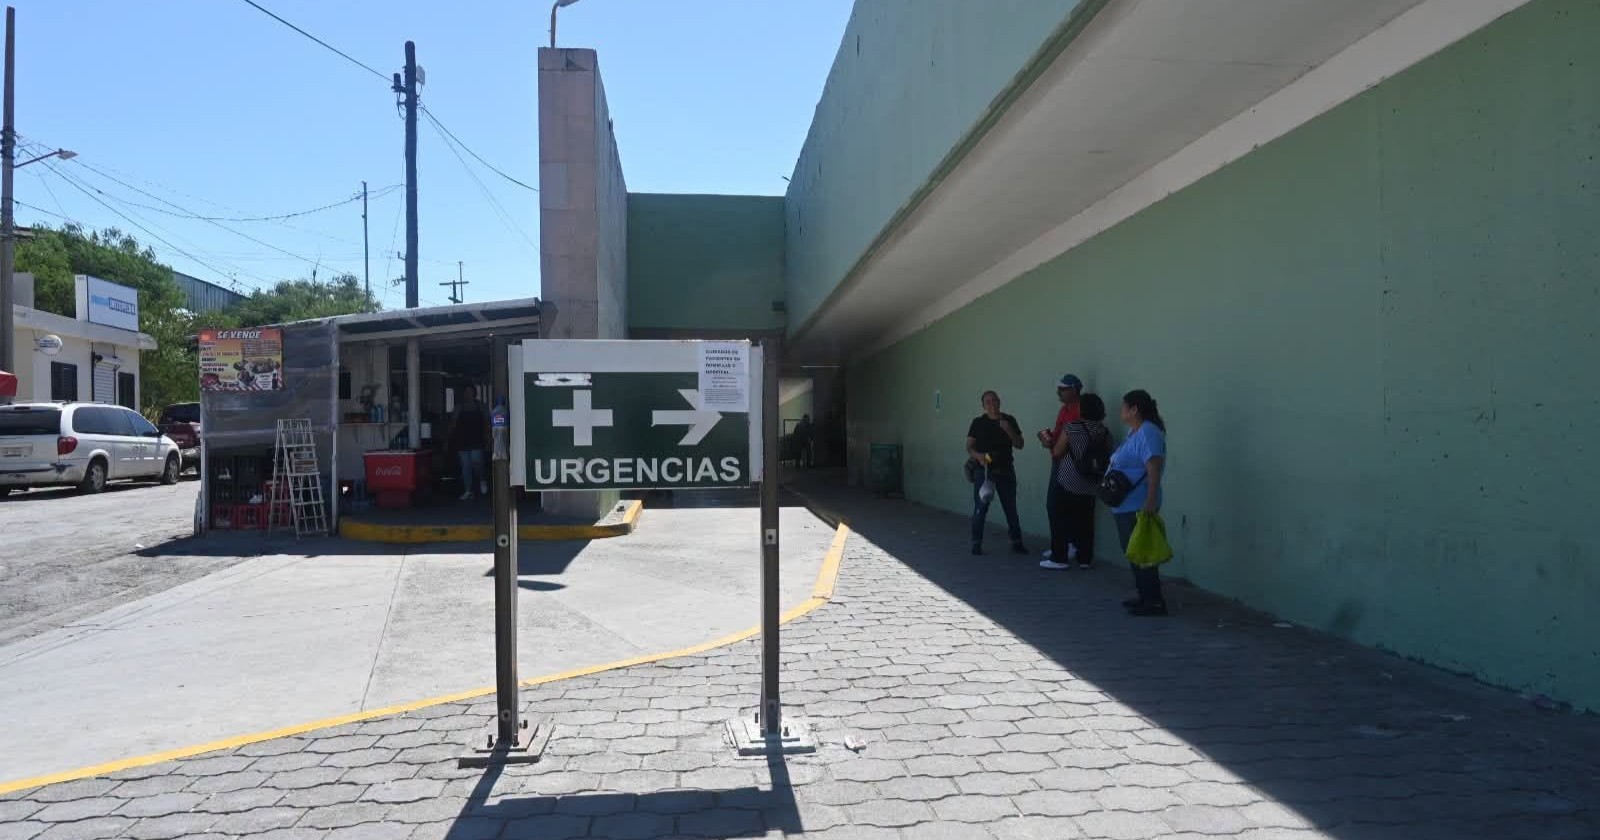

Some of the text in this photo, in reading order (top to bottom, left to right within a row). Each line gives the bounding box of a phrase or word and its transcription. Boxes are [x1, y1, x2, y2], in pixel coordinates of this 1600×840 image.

[216, 330, 262, 339] SE VENDE
[534, 456, 741, 484] URGENCIAS
